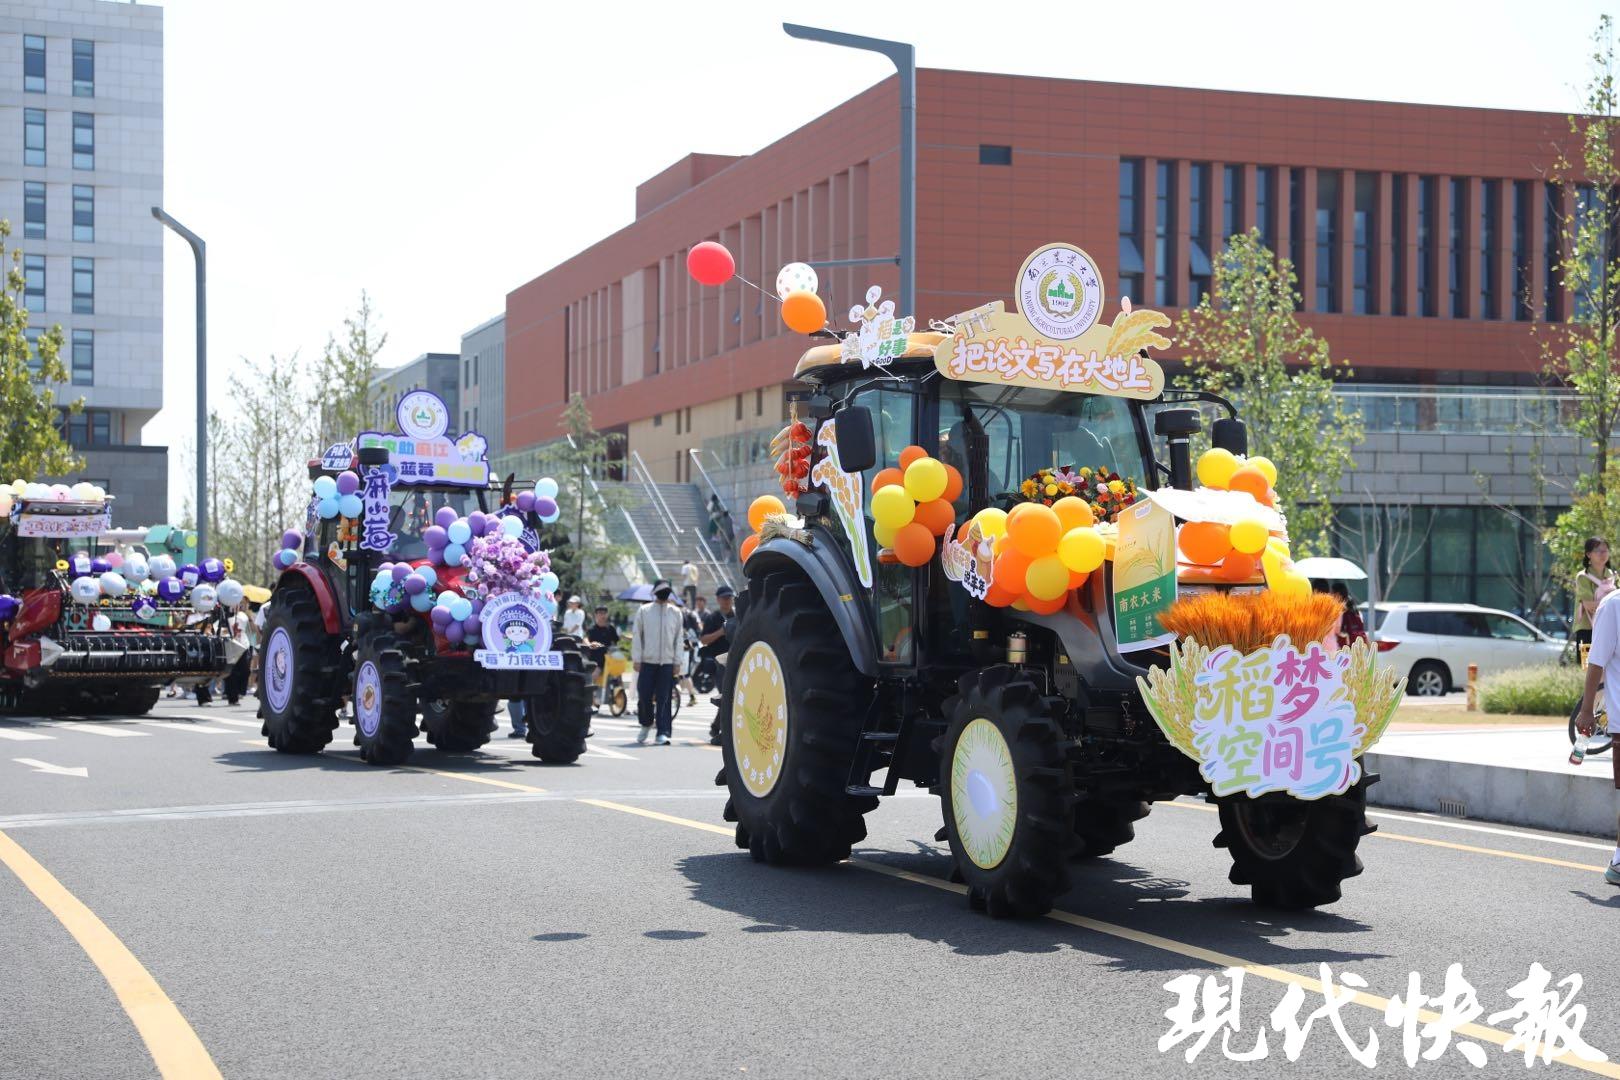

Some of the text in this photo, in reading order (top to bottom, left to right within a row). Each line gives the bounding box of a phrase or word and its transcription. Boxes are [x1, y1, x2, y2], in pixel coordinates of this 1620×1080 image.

[1033, 316, 1076, 336] AGRICULTURAL
[1074, 299, 1097, 331] UNIVERSITY
[1051, 299, 1070, 308] 1902
[950, 338, 1151, 391] 把论文写在大地上
[1119, 586, 1162, 613] 南农大米
[1199, 646, 1333, 725] 稻梦
[1217, 717, 1351, 795] 空间号
